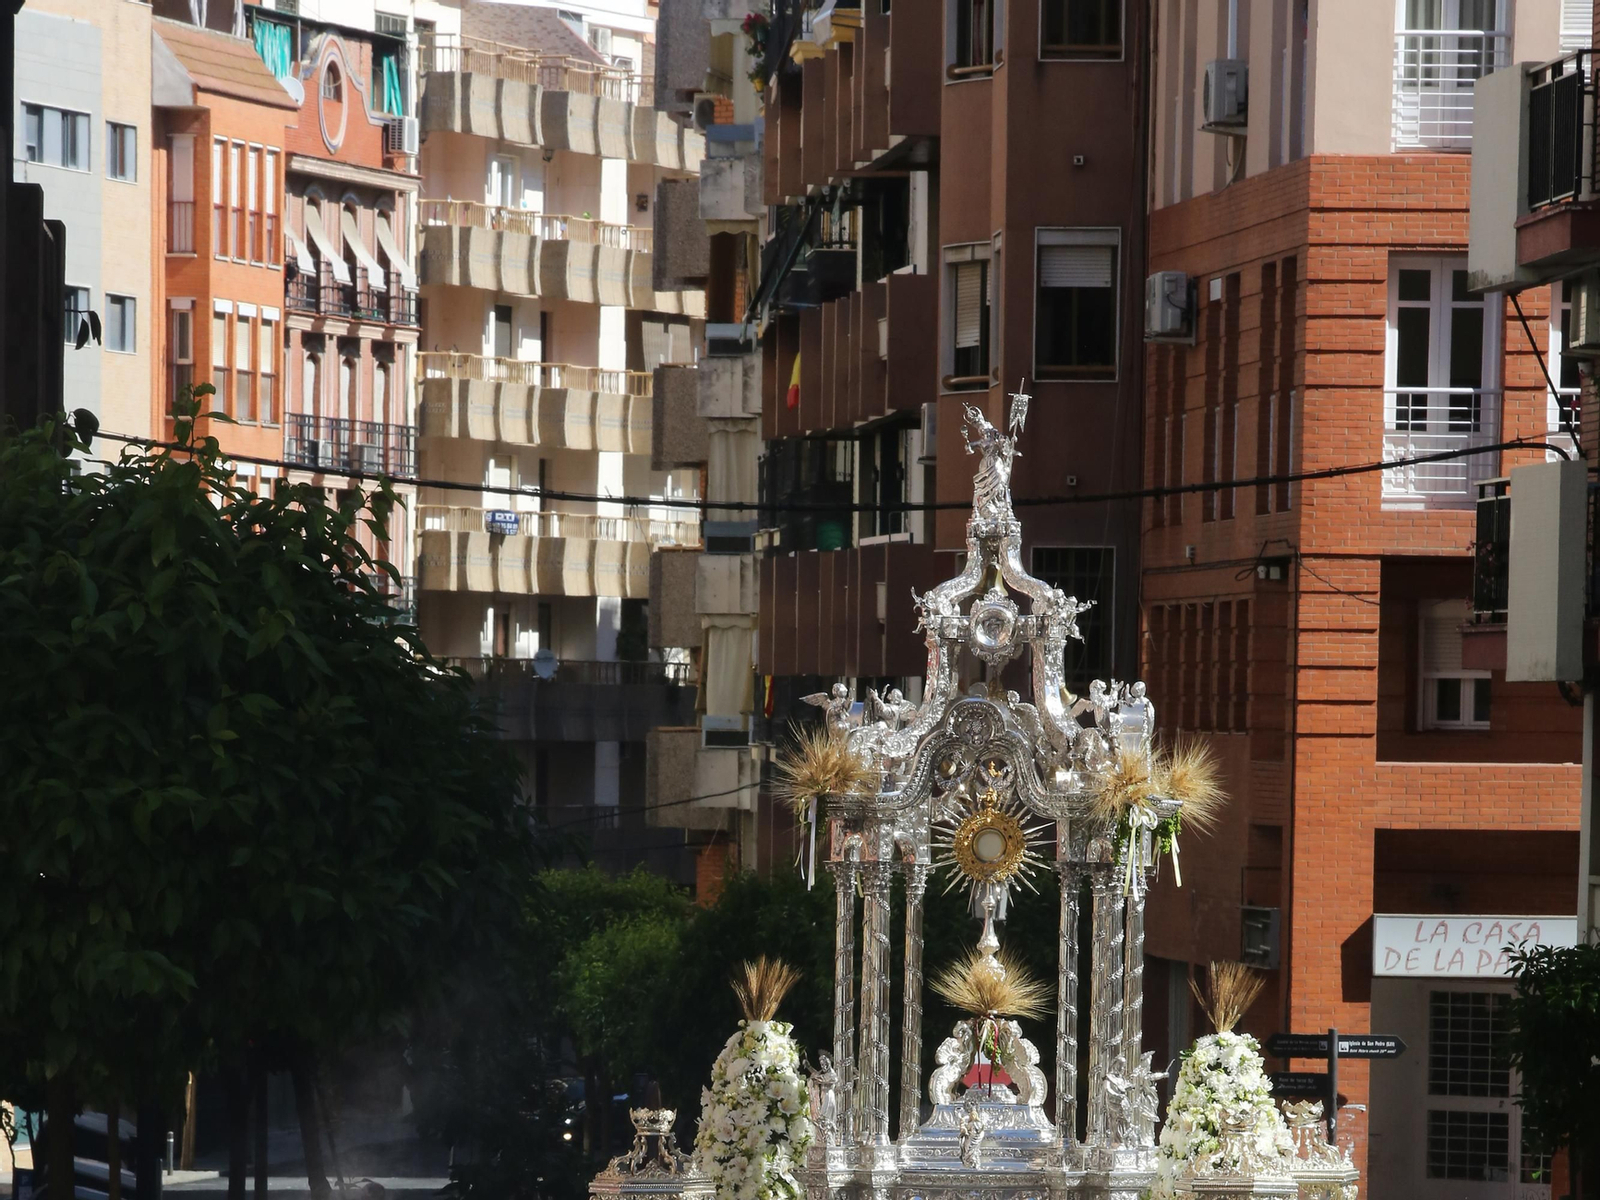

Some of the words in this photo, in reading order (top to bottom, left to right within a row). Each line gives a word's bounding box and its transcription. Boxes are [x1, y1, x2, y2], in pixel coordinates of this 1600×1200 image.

[1414, 920, 1448, 943] LA
[1463, 920, 1541, 945] CASA
[1384, 947, 1420, 972] DE
[1434, 947, 1464, 972] LA
